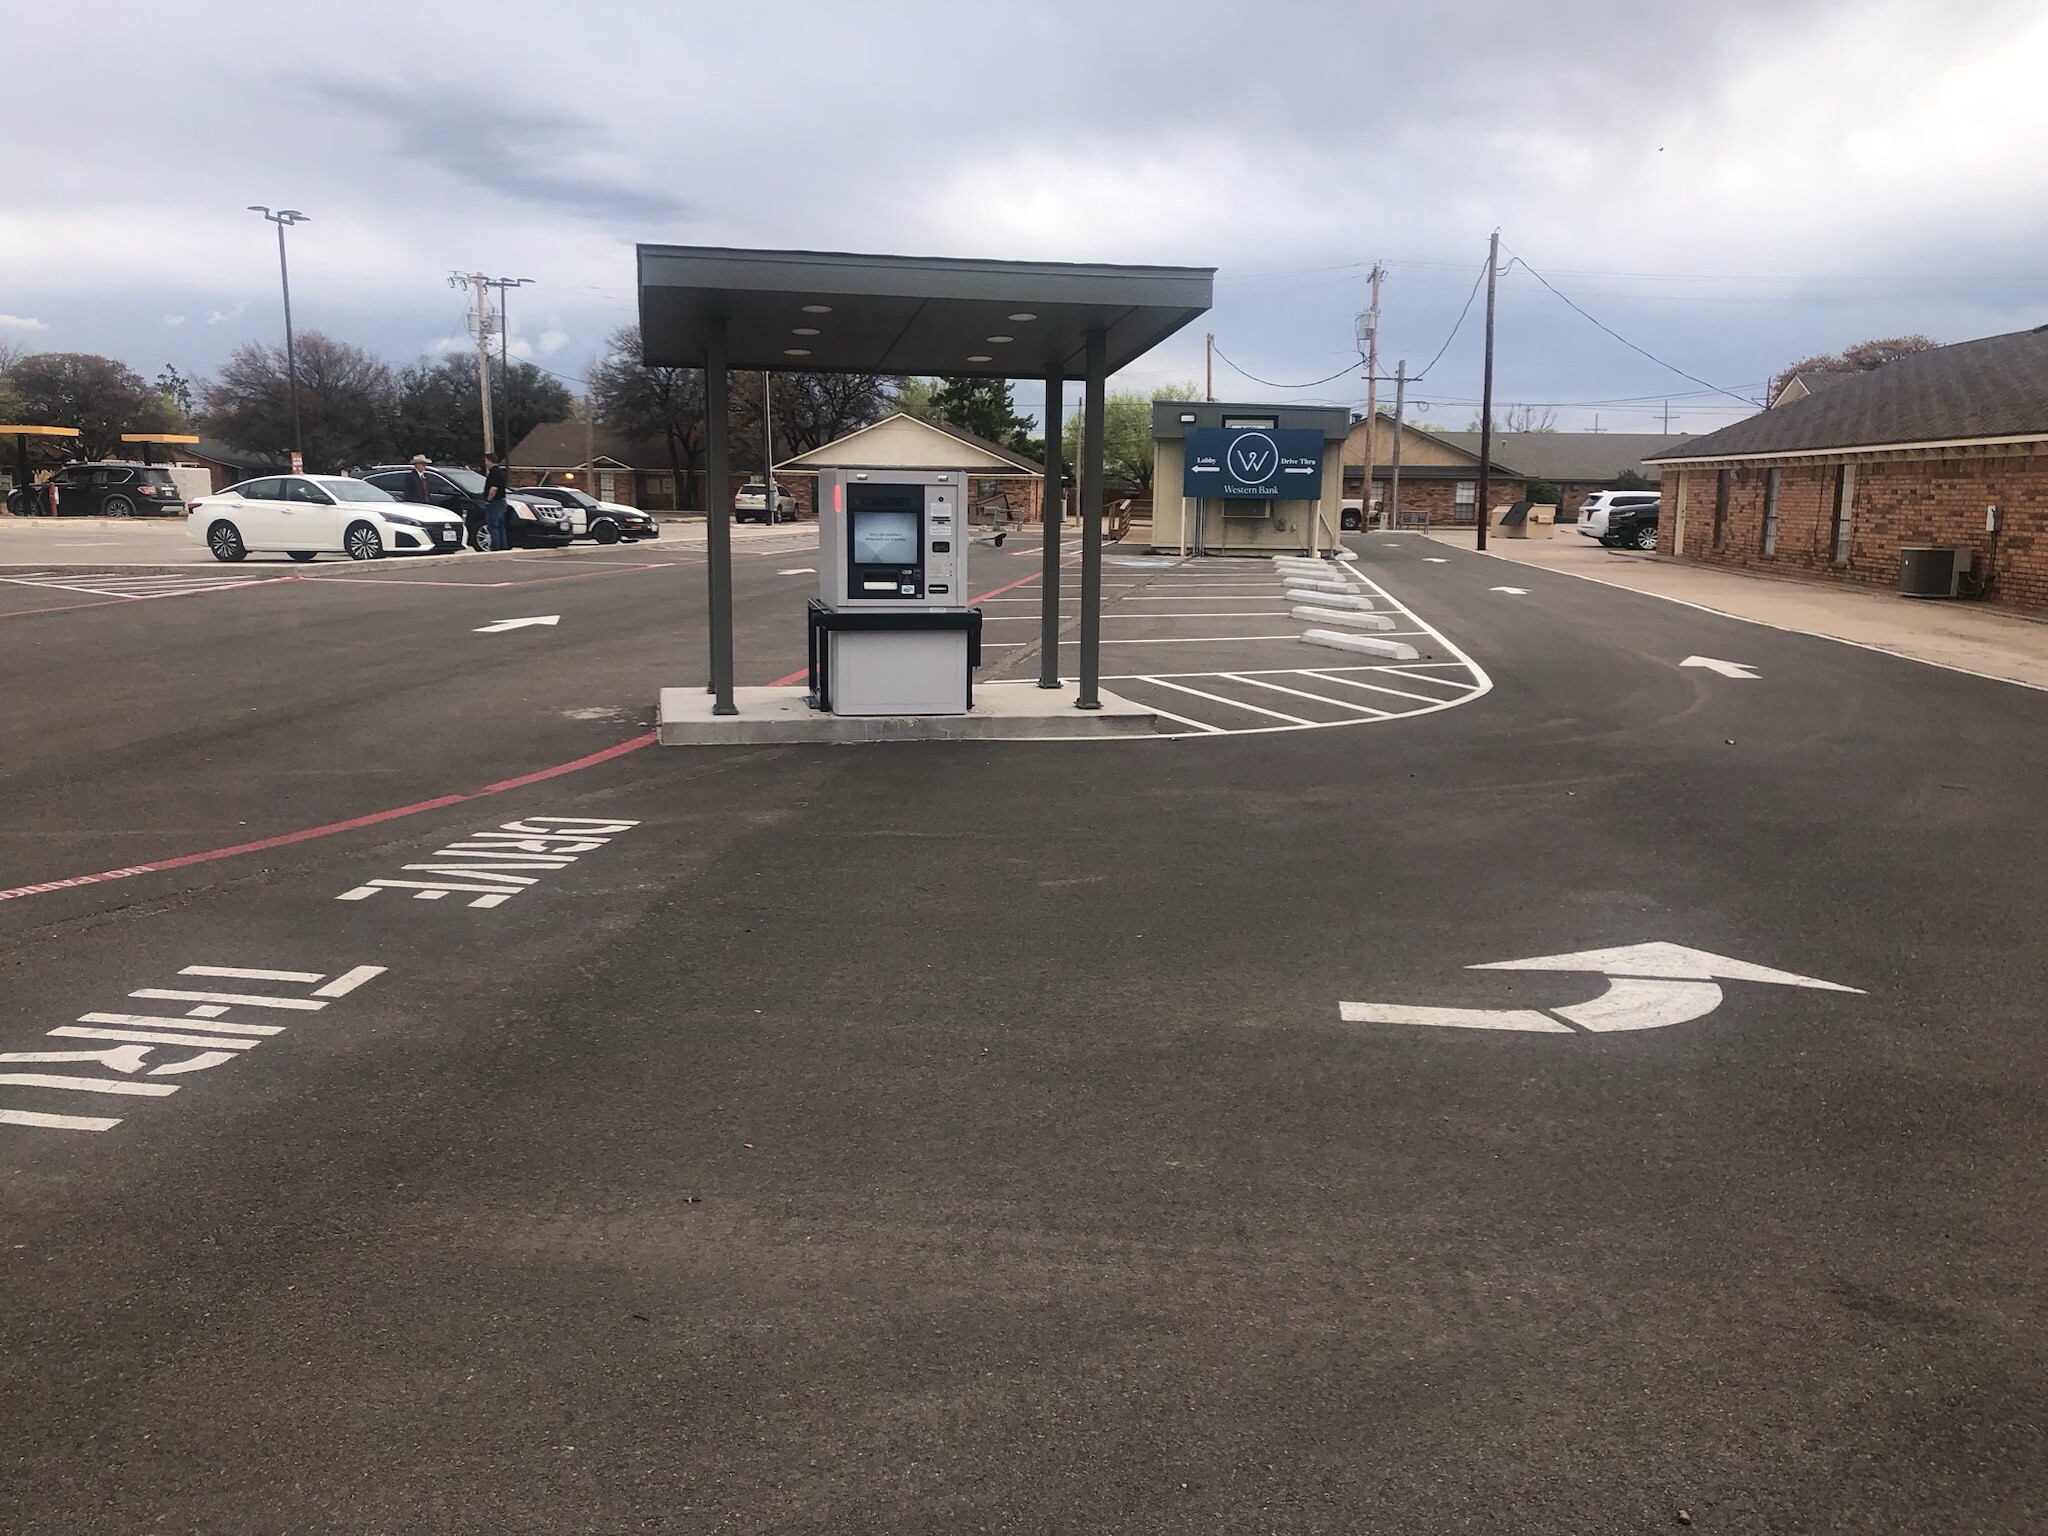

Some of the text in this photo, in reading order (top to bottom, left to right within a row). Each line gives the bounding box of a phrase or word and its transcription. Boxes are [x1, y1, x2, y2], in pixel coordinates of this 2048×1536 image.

[1197, 456, 1217, 465] Lobby
[1281, 457, 1298, 465] Drive
[1223, 485, 1279, 494] Western Bank
[334, 816, 642, 909] DRIVE
